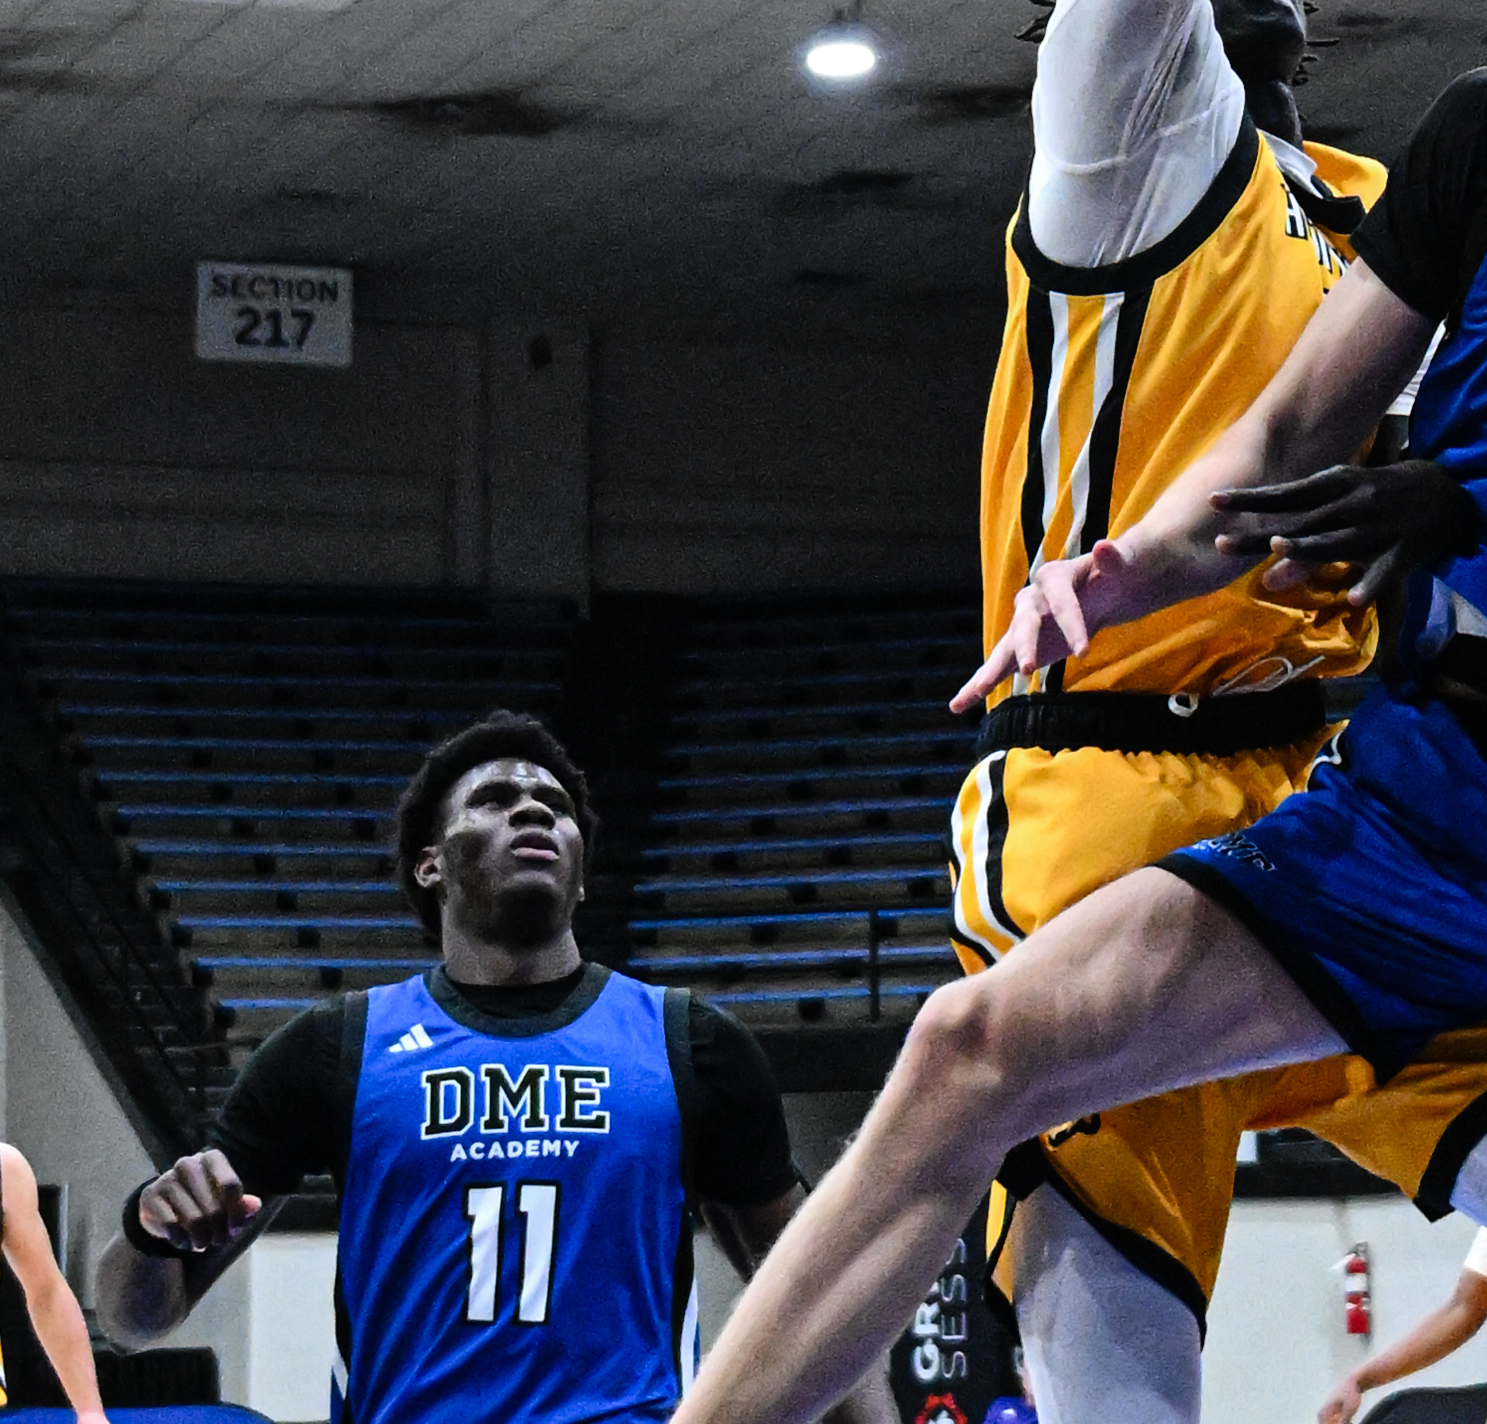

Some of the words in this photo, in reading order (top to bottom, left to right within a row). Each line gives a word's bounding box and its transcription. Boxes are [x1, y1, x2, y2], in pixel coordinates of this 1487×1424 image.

[212, 274, 338, 302] SECTION
[235, 306, 315, 351] 217
[421, 1063, 610, 1140] DME
[450, 1139, 580, 1163] ACADEMY
[464, 1182, 560, 1326] 11
